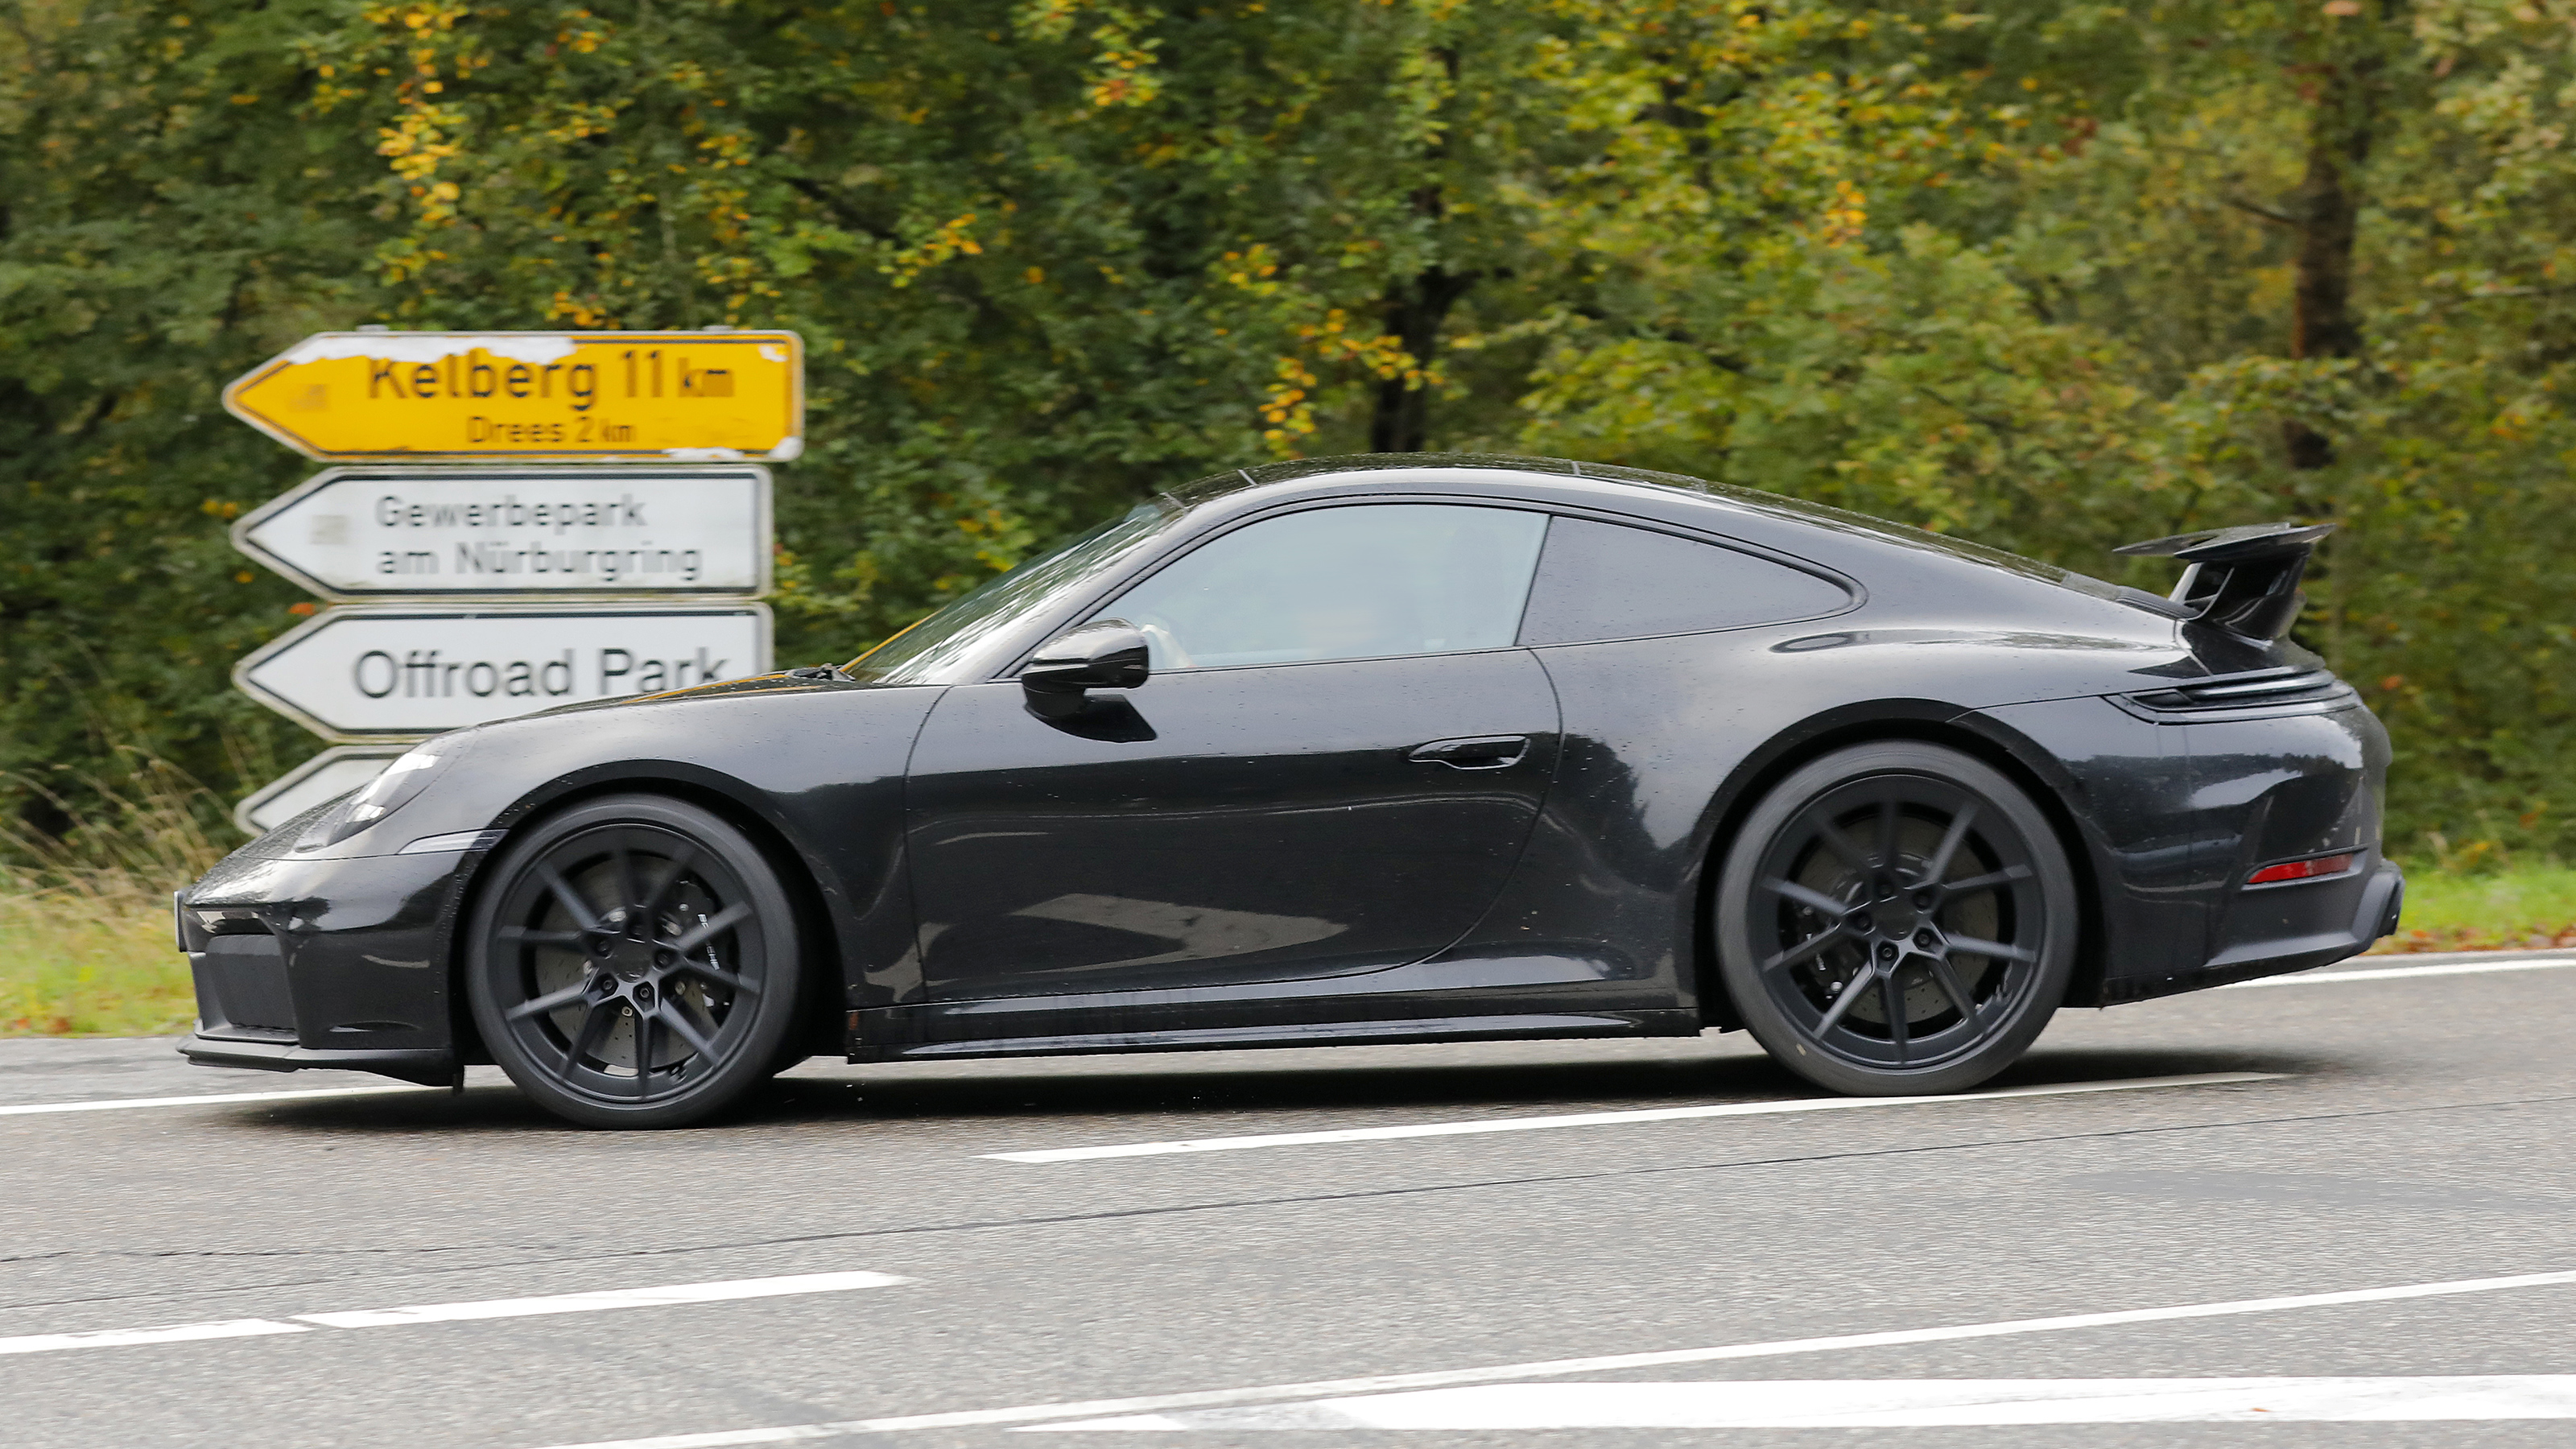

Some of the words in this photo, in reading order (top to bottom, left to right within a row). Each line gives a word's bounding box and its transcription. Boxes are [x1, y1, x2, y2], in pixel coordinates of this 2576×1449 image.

[367, 349, 597, 411] Kelberg
[621, 349, 663, 398] 11
[678, 357, 734, 398] km
[466, 415, 567, 443] Drees
[575, 415, 596, 443] 2
[599, 417, 637, 443] km
[375, 493, 647, 535] Gewerbepark
[378, 550, 440, 574] am
[455, 540, 703, 582] Nürburgring
[353, 647, 576, 699] Offroad
[597, 646, 729, 696] Park
